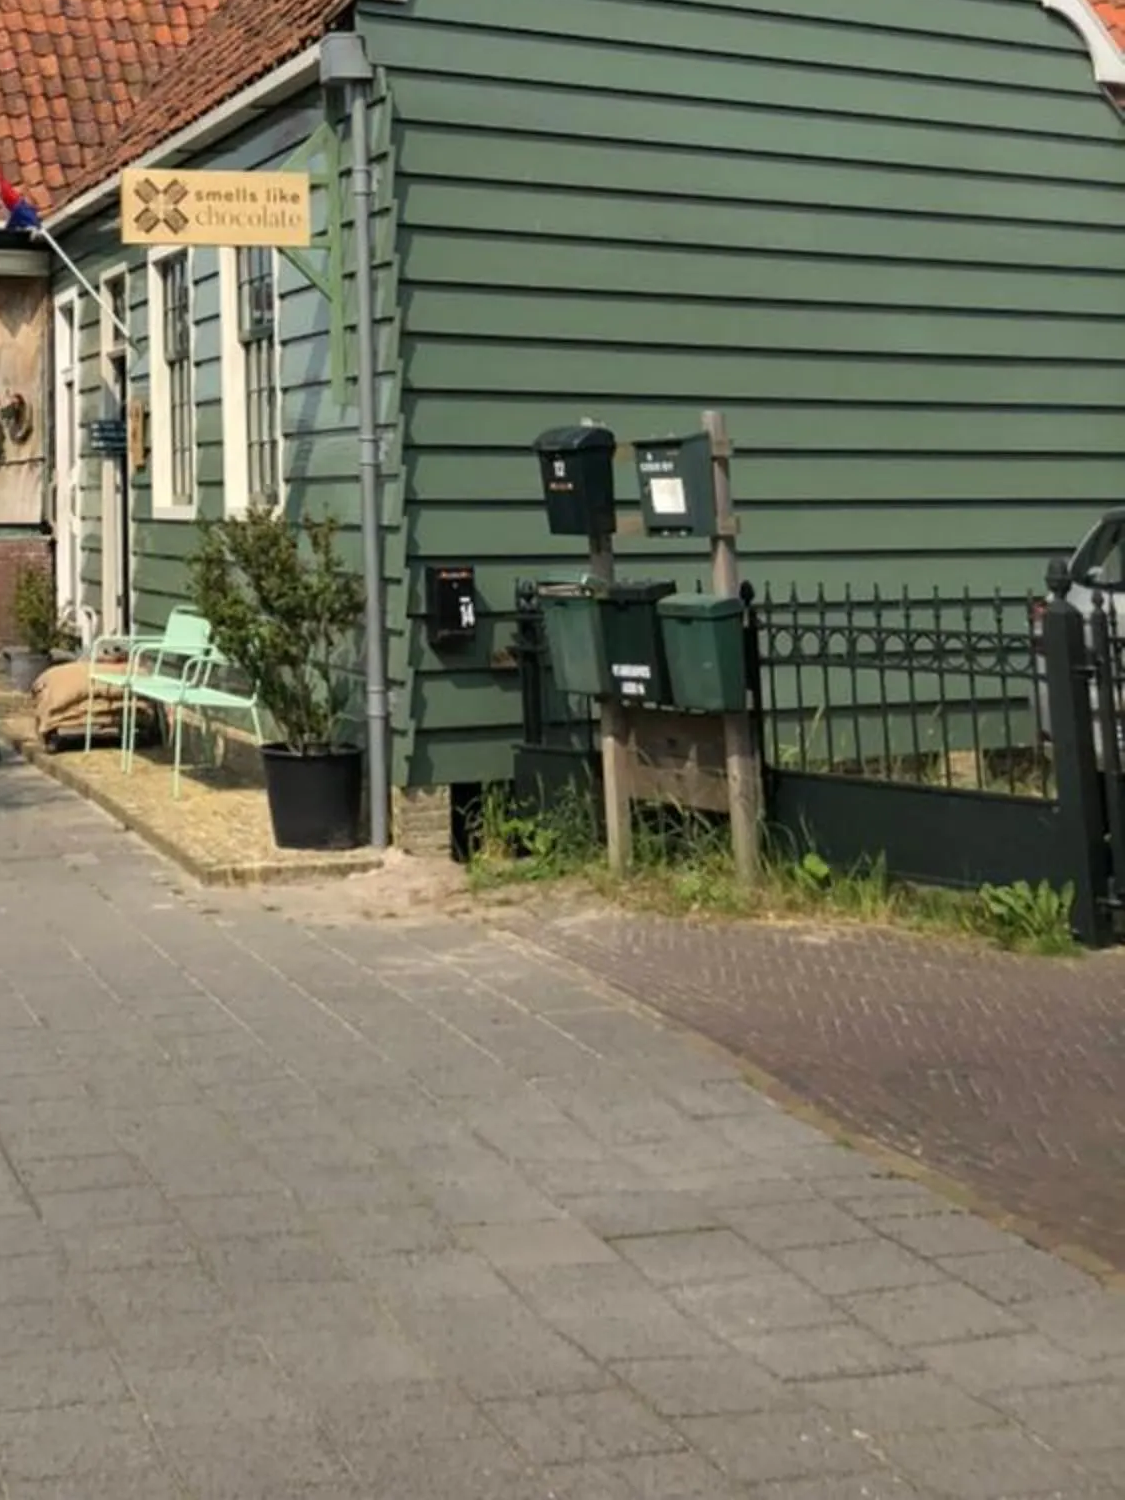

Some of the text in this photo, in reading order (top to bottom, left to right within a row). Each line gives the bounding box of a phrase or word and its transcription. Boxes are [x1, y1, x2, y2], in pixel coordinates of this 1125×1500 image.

[194, 187, 301, 204] smells like
[194, 205, 302, 228] chocolate
